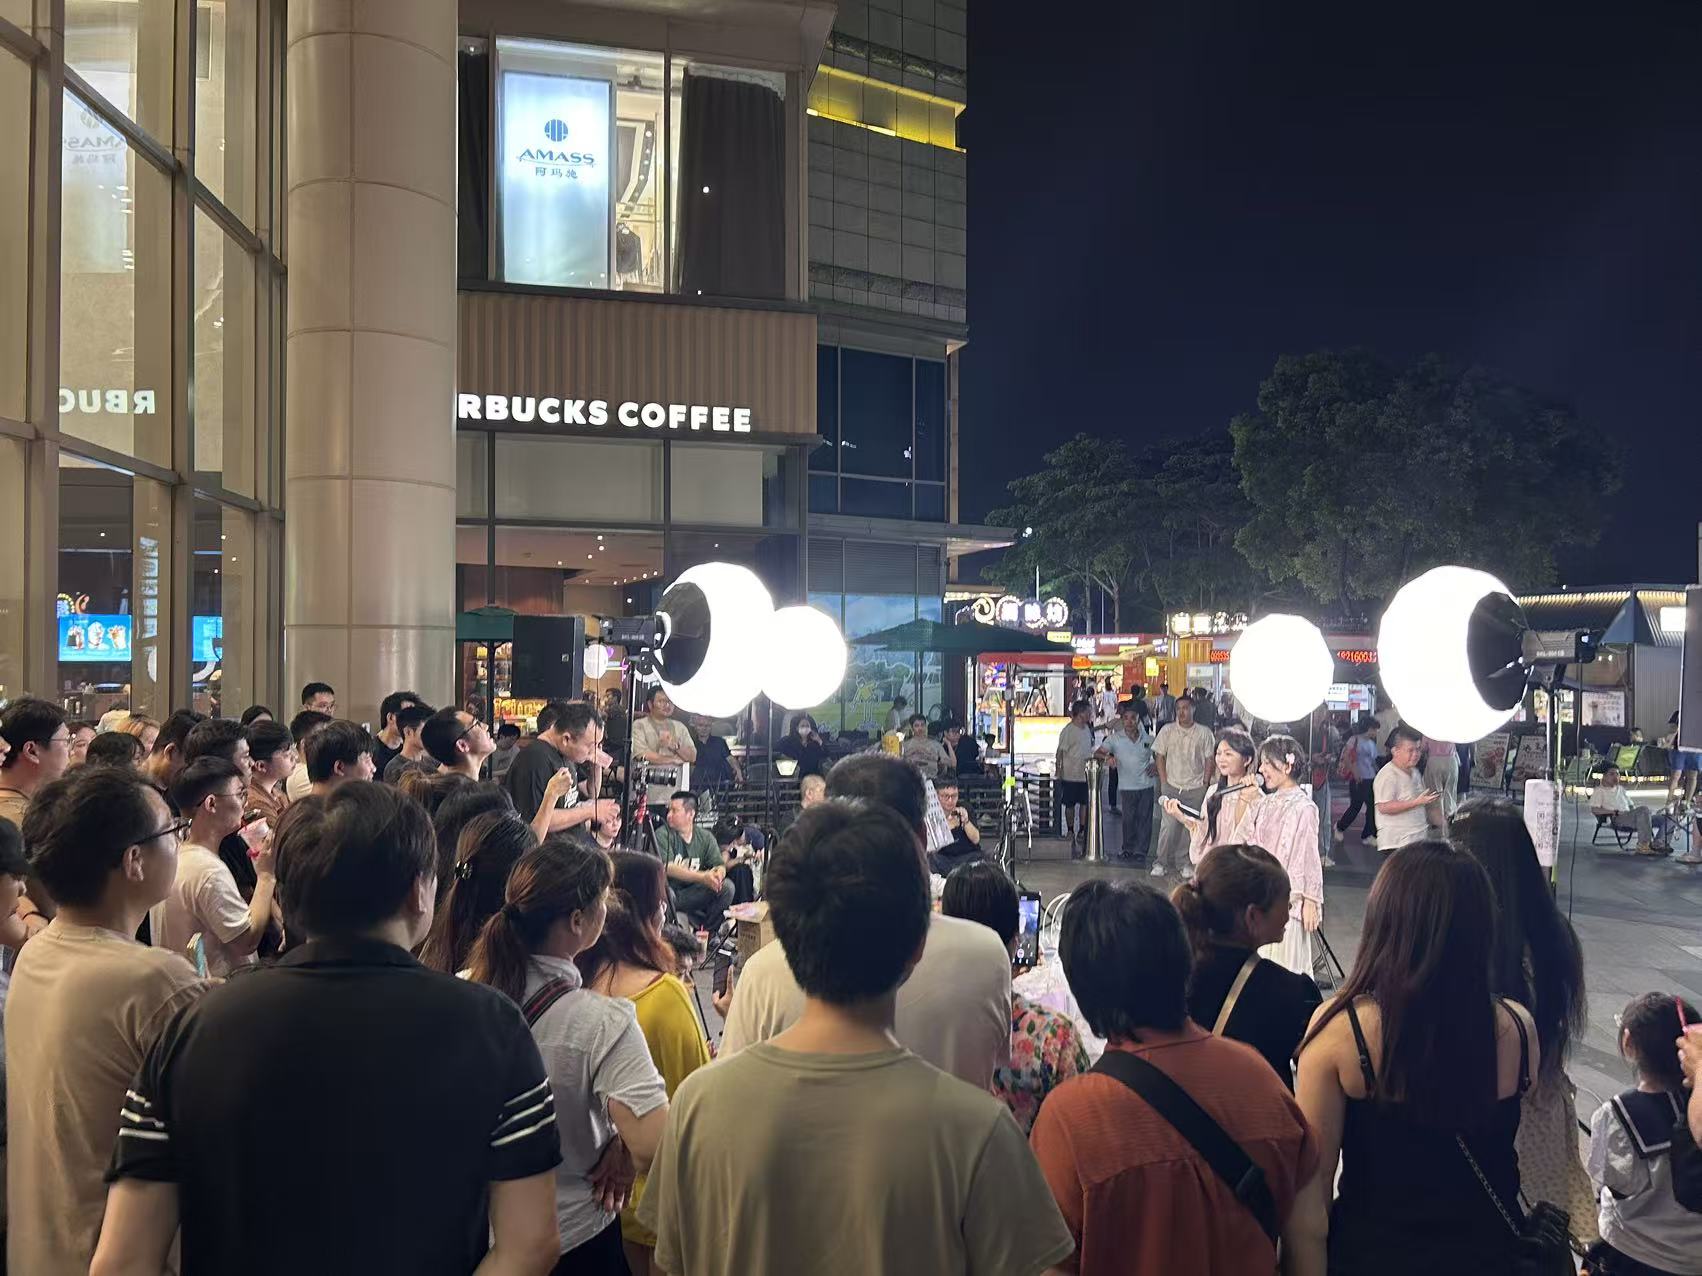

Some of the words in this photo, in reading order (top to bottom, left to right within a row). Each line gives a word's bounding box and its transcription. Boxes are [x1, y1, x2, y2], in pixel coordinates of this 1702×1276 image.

[519, 148, 595, 165] AMASS
[458, 393, 608, 426] RBUCKS
[618, 401, 751, 432] COFFEE
